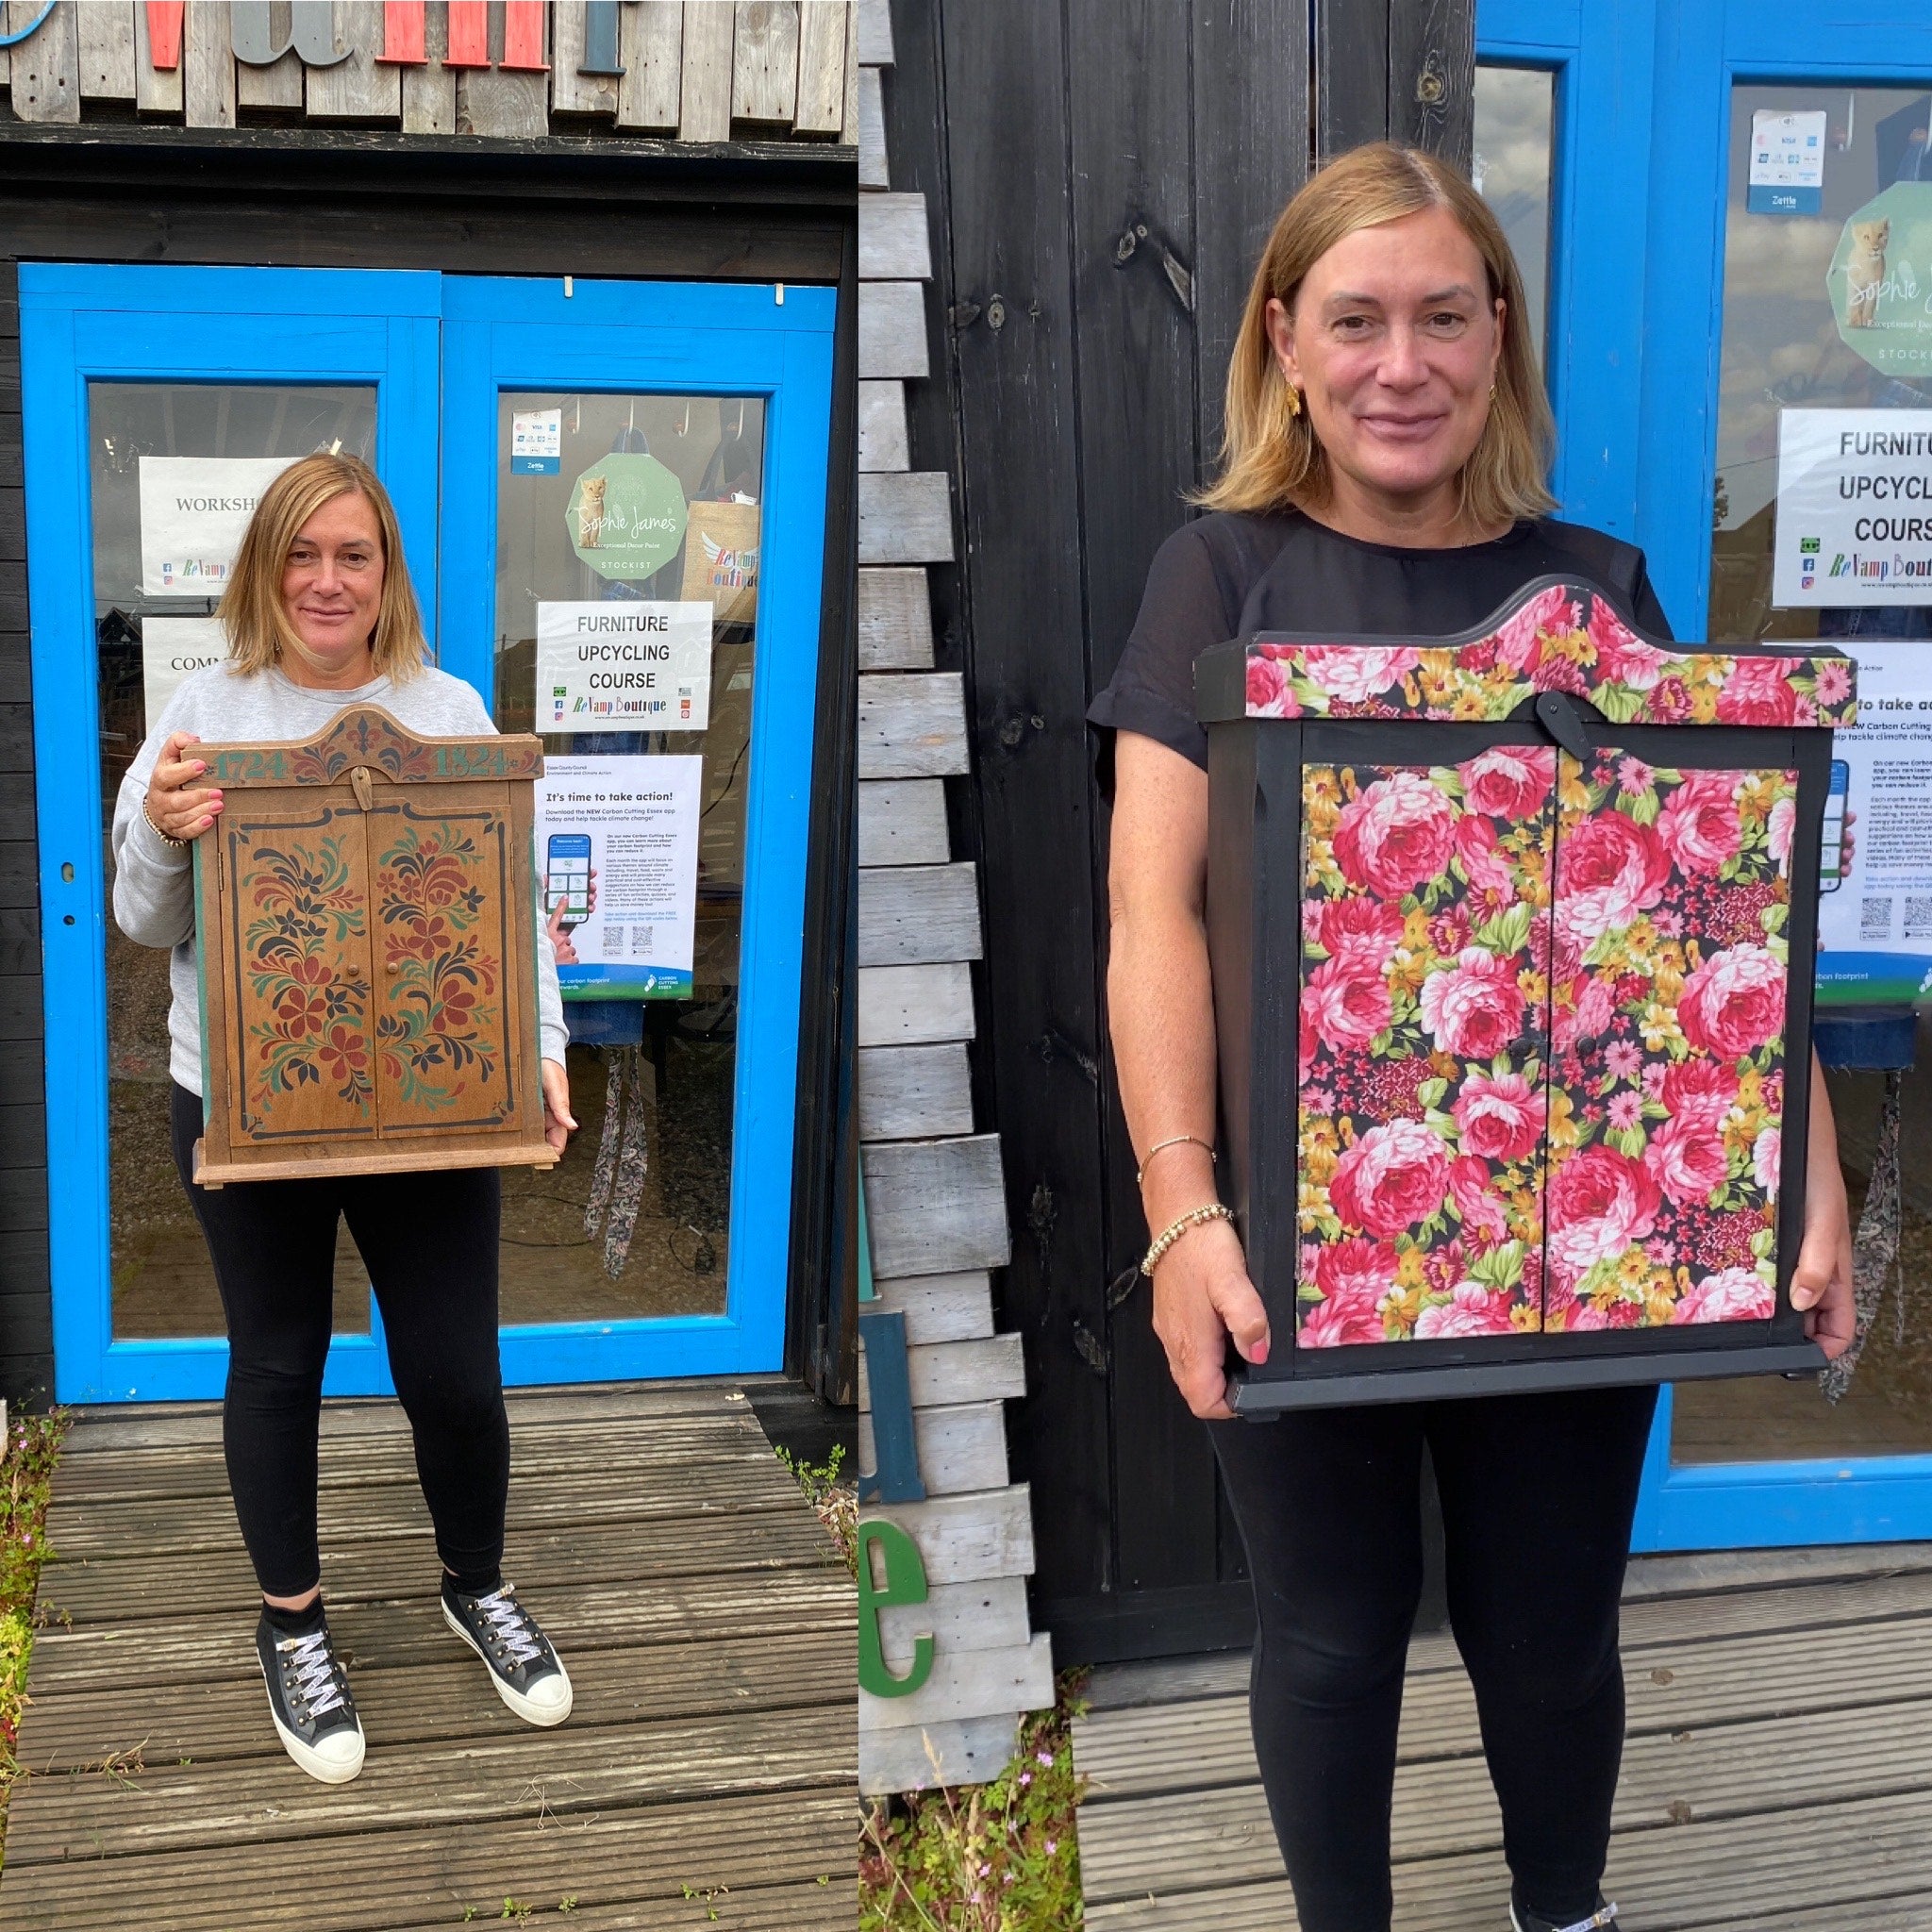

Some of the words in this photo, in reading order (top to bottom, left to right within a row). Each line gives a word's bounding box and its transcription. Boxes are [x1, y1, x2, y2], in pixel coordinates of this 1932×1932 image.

[1841, 264, 1921, 310] Sophie
[175, 498, 258, 511] WORKSH
[574, 507, 628, 537] Sophie
[631, 506, 676, 539] James
[182, 559, 225, 578] ReVamp
[1828, 554, 1888, 581] ReVamp
[577, 616, 668, 632] FURNITURE
[579, 645, 670, 660] UPCYCLING
[590, 673, 656, 689] COURSE
[573, 696, 613, 715] ReVamp
[616, 696, 666, 714] Boutique
[1858, 699, 1874, 709] to
[1879, 697, 1913, 709] take
[1901, 722, 1931, 731] Cutting
[1834, 733, 1846, 741] elp
[213, 752, 287, 781] 1724
[435, 746, 509, 777] 1824
[547, 793, 565, 802] It's
[568, 792, 591, 801] time
[609, 792, 633, 801] take
[636, 791, 673, 801] action!
[1835, 973, 1869, 981] footprint
